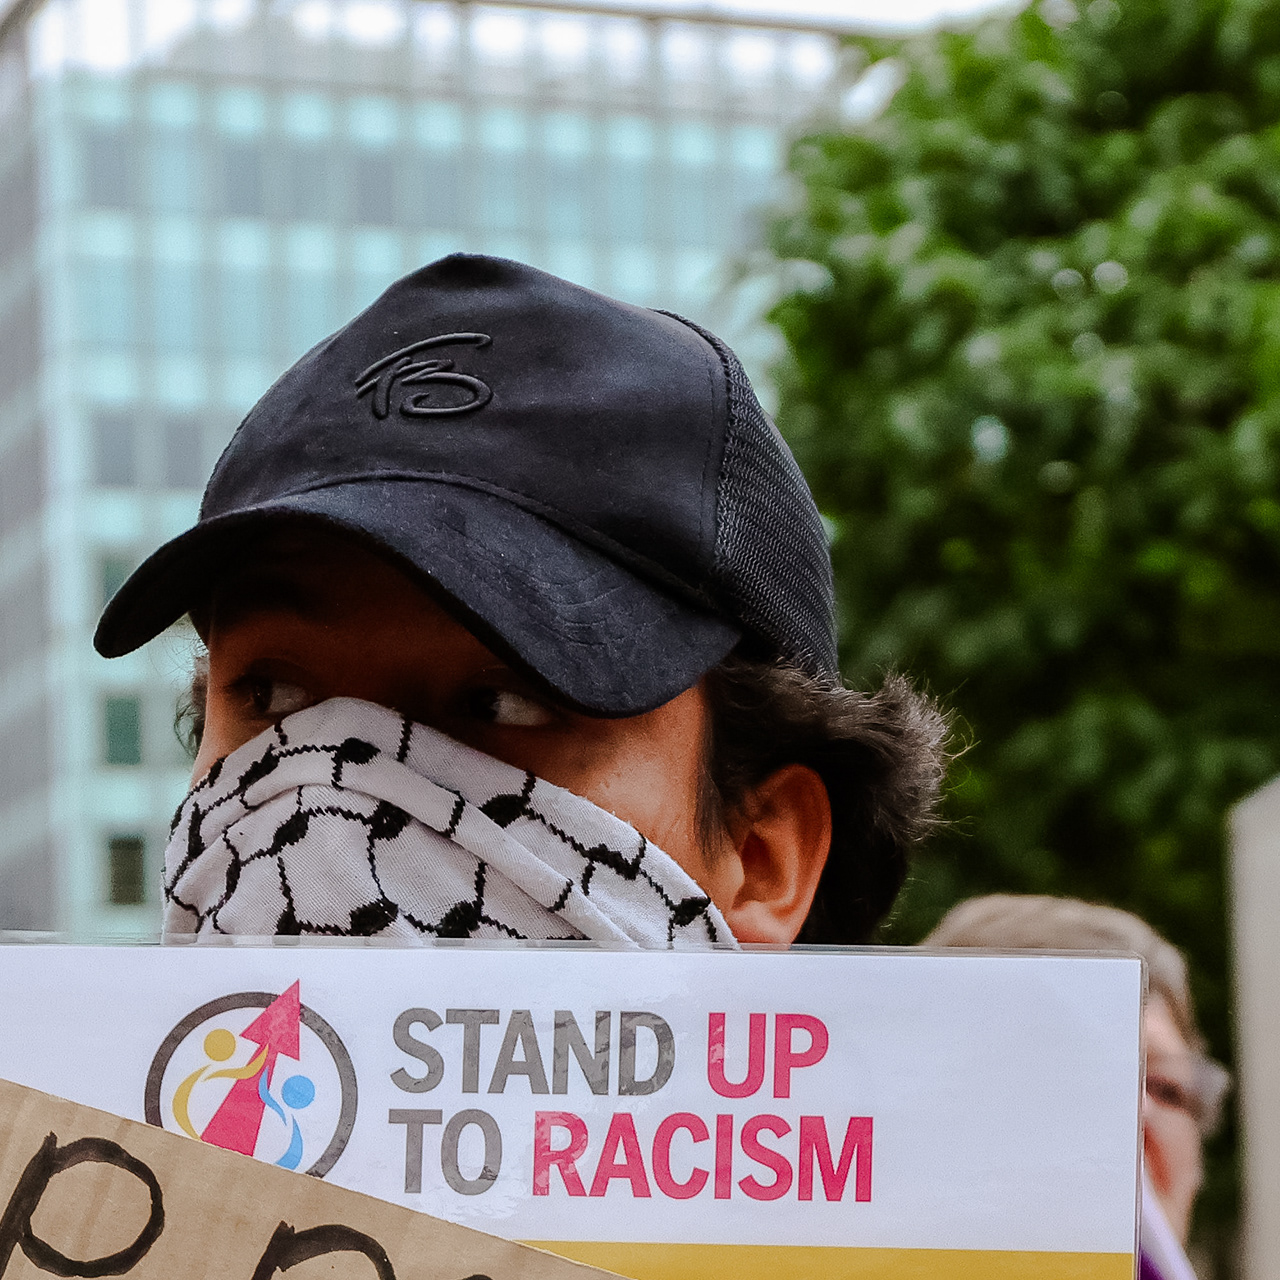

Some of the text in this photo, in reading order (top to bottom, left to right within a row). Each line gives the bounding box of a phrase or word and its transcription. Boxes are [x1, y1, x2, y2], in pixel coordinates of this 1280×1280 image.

[389, 1007, 831, 1100] STAND UP
[388, 1108, 875, 1204] TO RACISM
